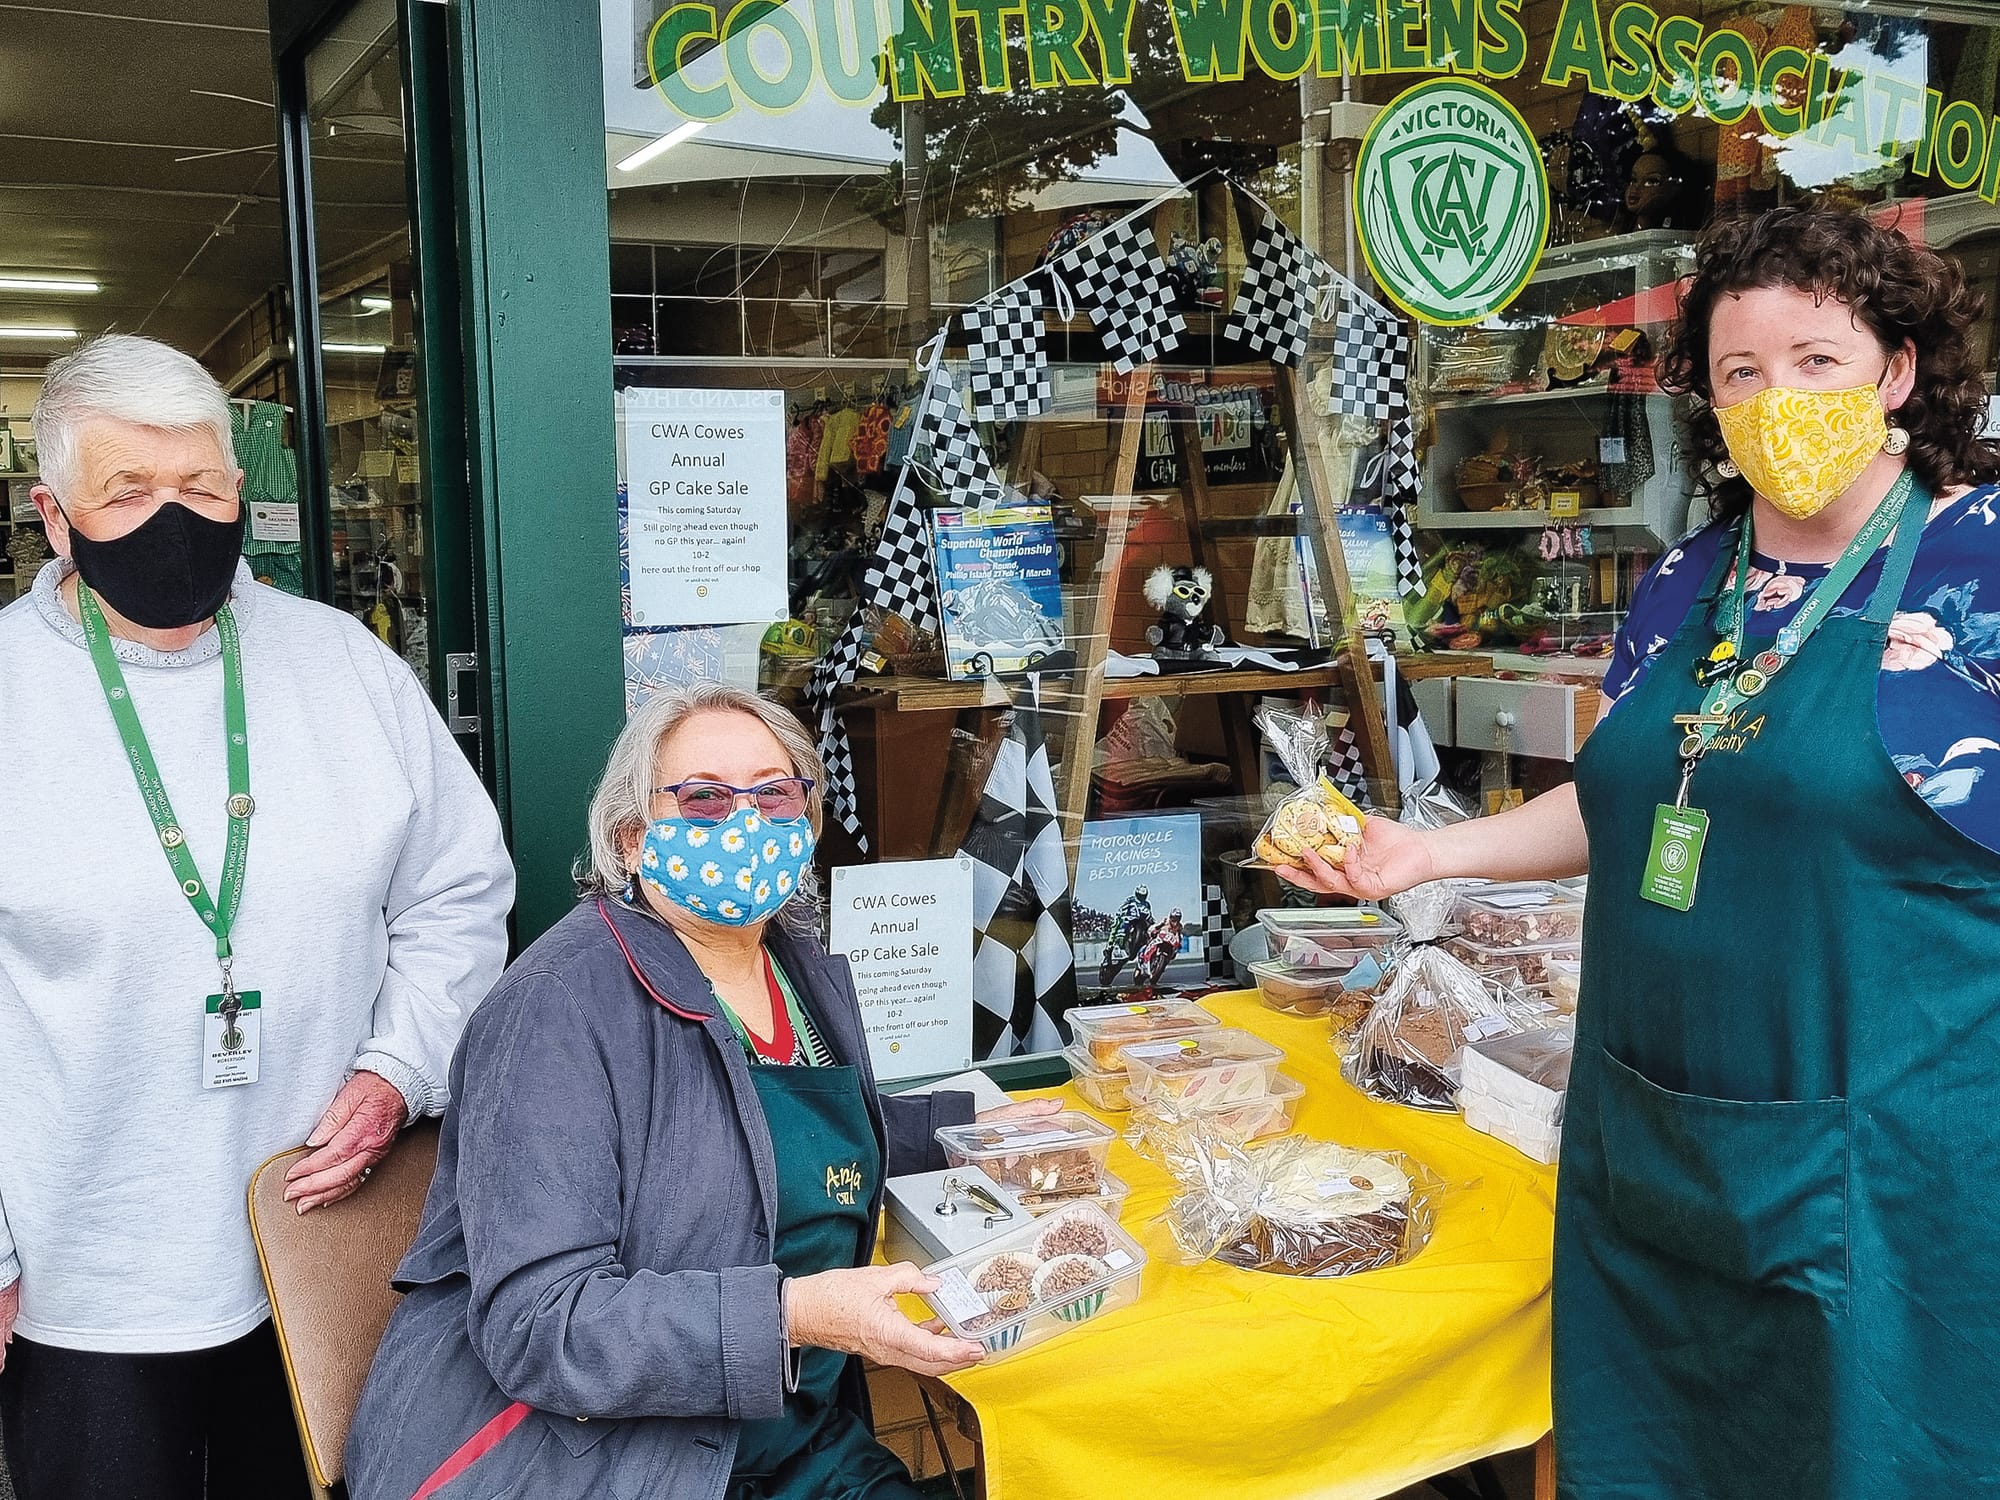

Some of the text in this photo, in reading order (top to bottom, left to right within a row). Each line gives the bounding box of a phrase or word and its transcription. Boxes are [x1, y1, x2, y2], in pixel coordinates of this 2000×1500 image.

[648, 0, 1138, 122] COUNTRY
[1165, 0, 1527, 84] WOMENS
[1402, 102, 1510, 143] VICTORIA
[651, 424, 744, 439] CWA Cowes
[671, 452, 725, 467] Annual
[649, 480, 749, 495] GP Cake Sale
[657, 506, 741, 516] This coming Saturday
[660, 524, 682, 533] going
[683, 523, 708, 531] ahead
[709, 523, 728, 531] even
[730, 522, 759, 532] though
[1880, 519, 1889, 530] OF
[666, 537, 678, 545] GP
[680, 537, 695, 545] this
[941, 534, 1024, 550] Superbike World
[1847, 543, 1862, 558] THE
[1860, 512, 1885, 545] COUNTRY
[692, 551, 710, 559] 10-2
[980, 544, 1052, 558] Championship
[641, 566, 660, 574] here
[662, 566, 675, 574] out
[677, 565, 691, 573] the
[691, 564, 711, 573] front
[741, 564, 761, 574] shop
[969, 570, 992, 579] Island
[1026, 568, 1052, 577] March
[1092, 830, 1173, 848] MOTORCYCLE
[228, 836, 239, 871] VICTORIA
[1104, 848, 1161, 864] RACING'S
[1089, 861, 1178, 881] BEST ADDRESS
[853, 894, 937, 910] CWA Cowes
[870, 918, 919, 935] Annual
[850, 942, 939, 963] GP Cake Sale
[873, 969, 900, 978] coming
[900, 966, 932, 976] Saturday
[880, 984, 902, 993] ahead
[921, 980, 948, 989] though
[864, 999, 875, 1008] GP
[876, 998, 889, 1006] this
[887, 1009, 903, 1018] 10-2
[886, 1023, 904, 1031] front
[931, 1018, 949, 1027] shop
[826, 1162, 861, 1198] Anja
